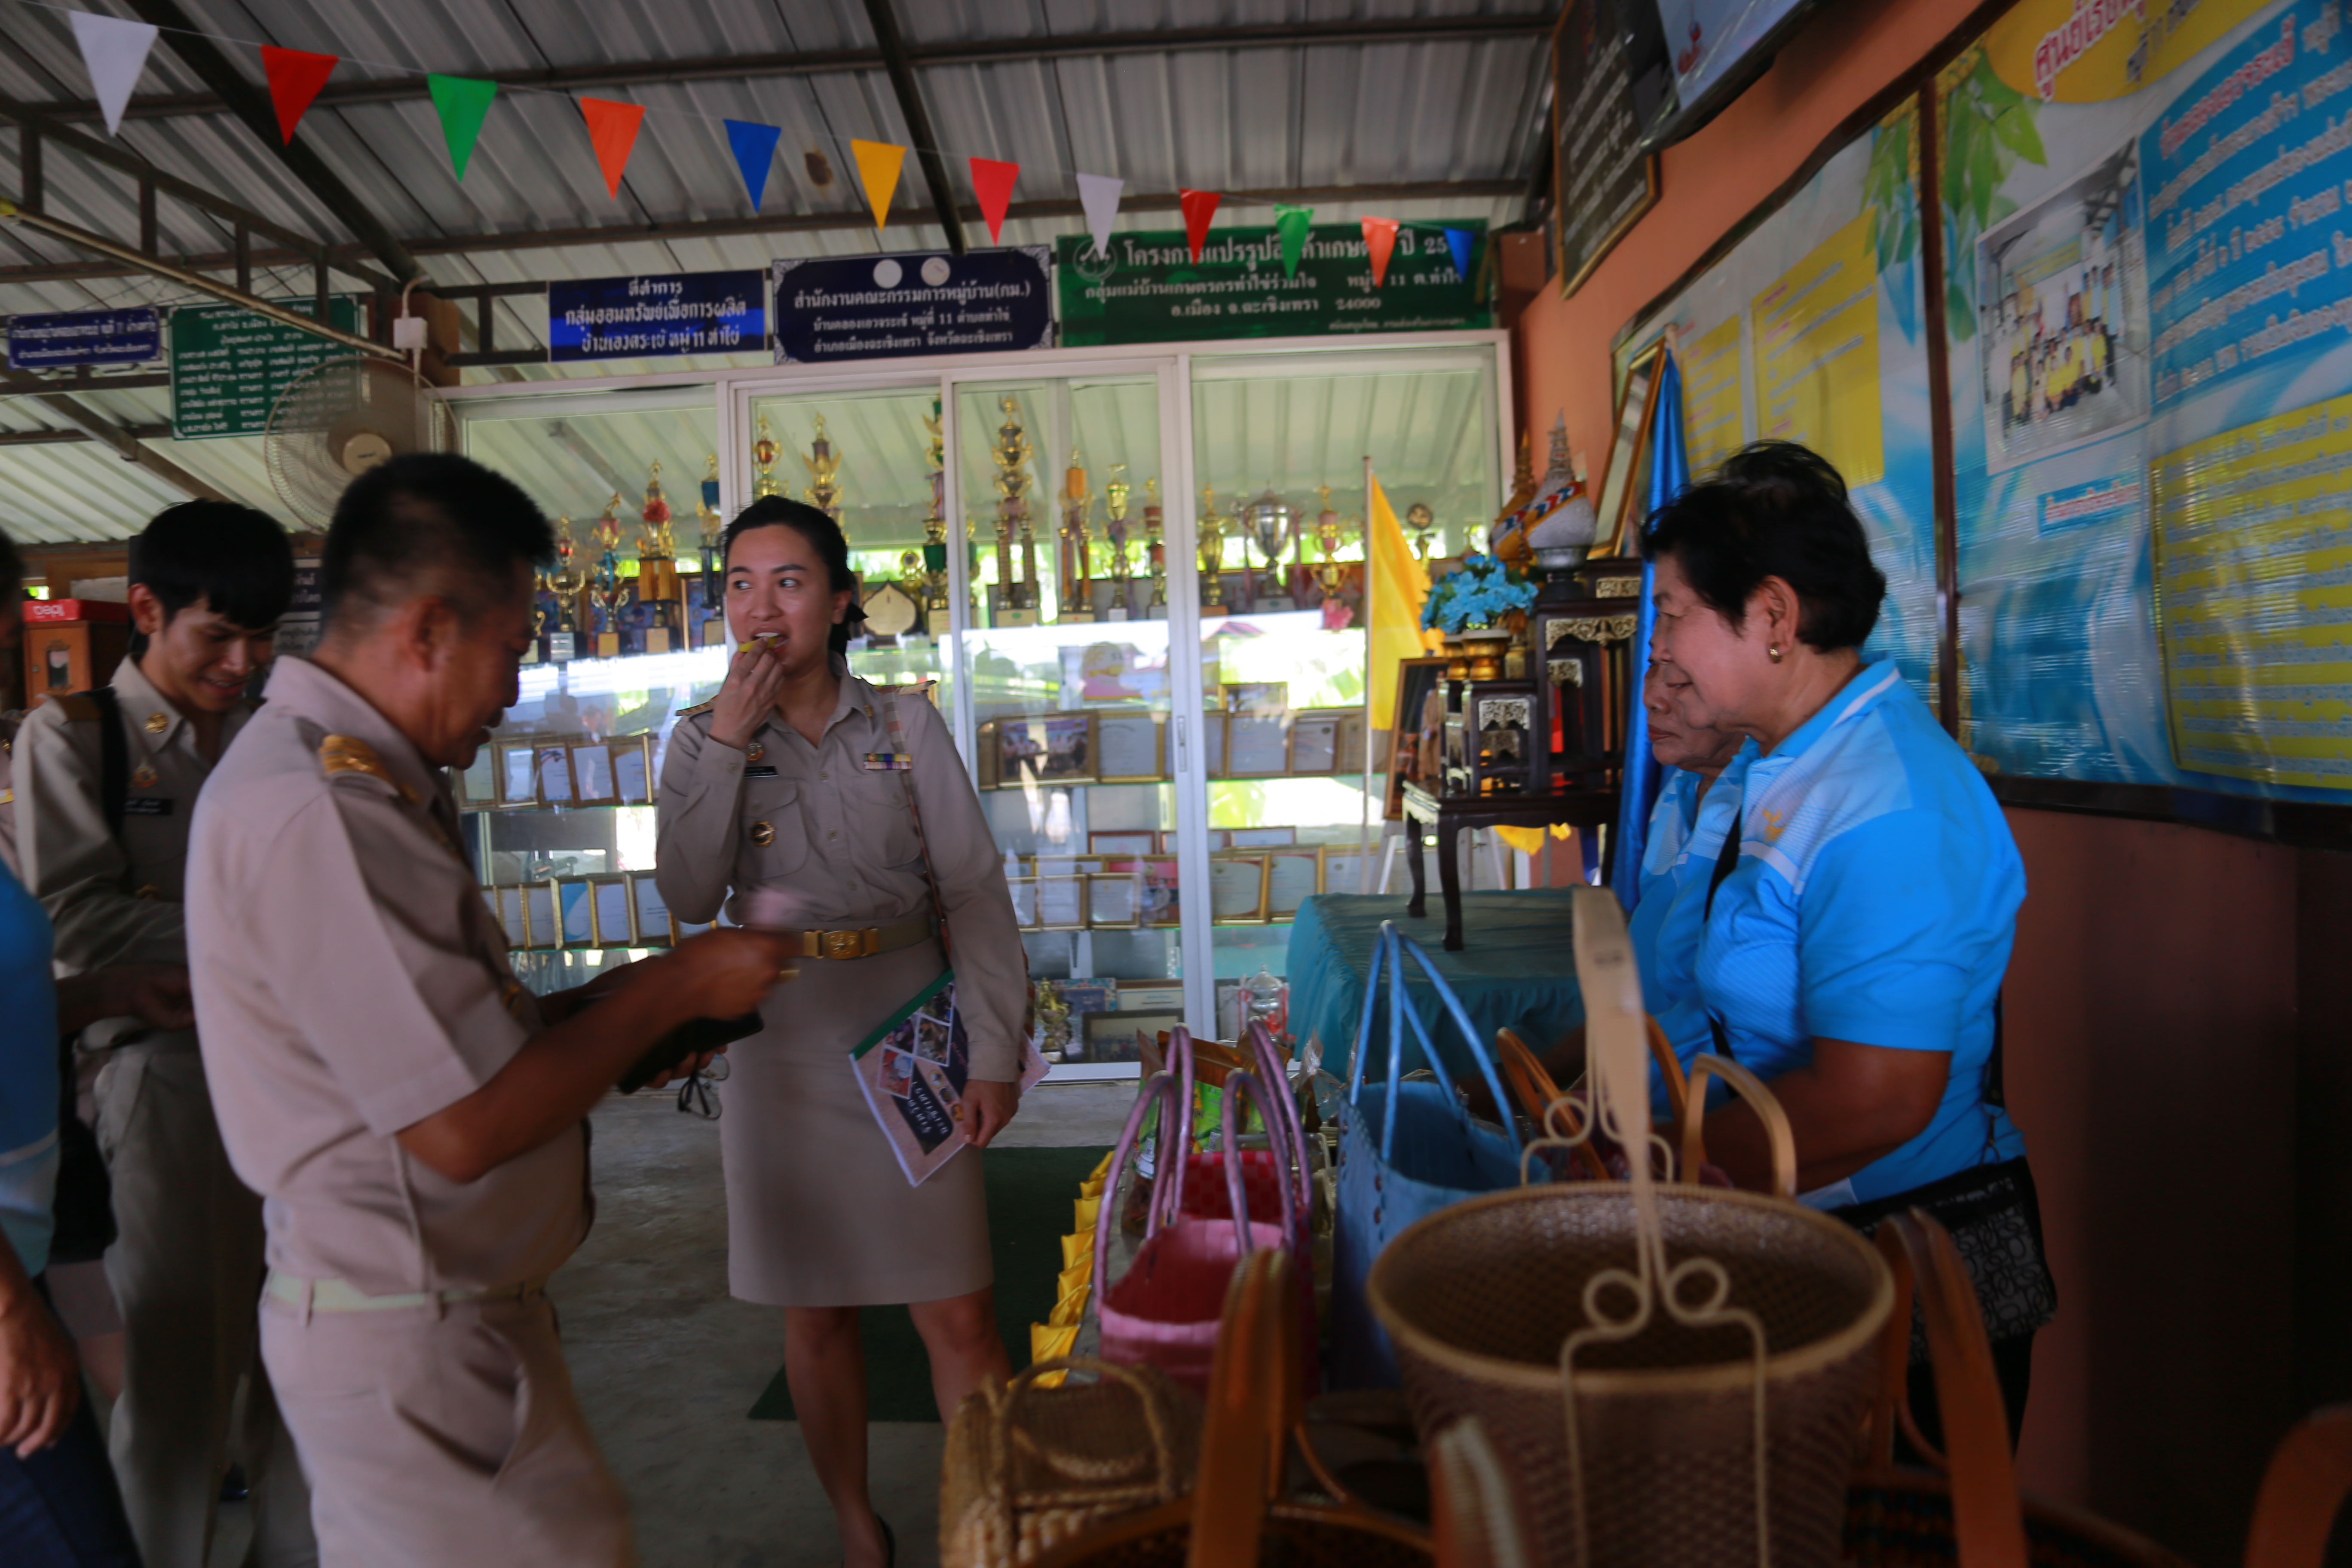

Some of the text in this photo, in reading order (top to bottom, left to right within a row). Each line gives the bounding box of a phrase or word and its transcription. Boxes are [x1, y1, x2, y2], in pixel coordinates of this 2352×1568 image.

[1397, 228, 1415, 255] ปี
[628, 276, 683, 297] ที่ทำการ
[1390, 274, 1406, 286] 11
[1335, 297, 1382, 310] 24000
[565, 295, 746, 331] กลุ่มออมทรัพย์เพื่อการผลิต
[939, 313, 952, 325] 11
